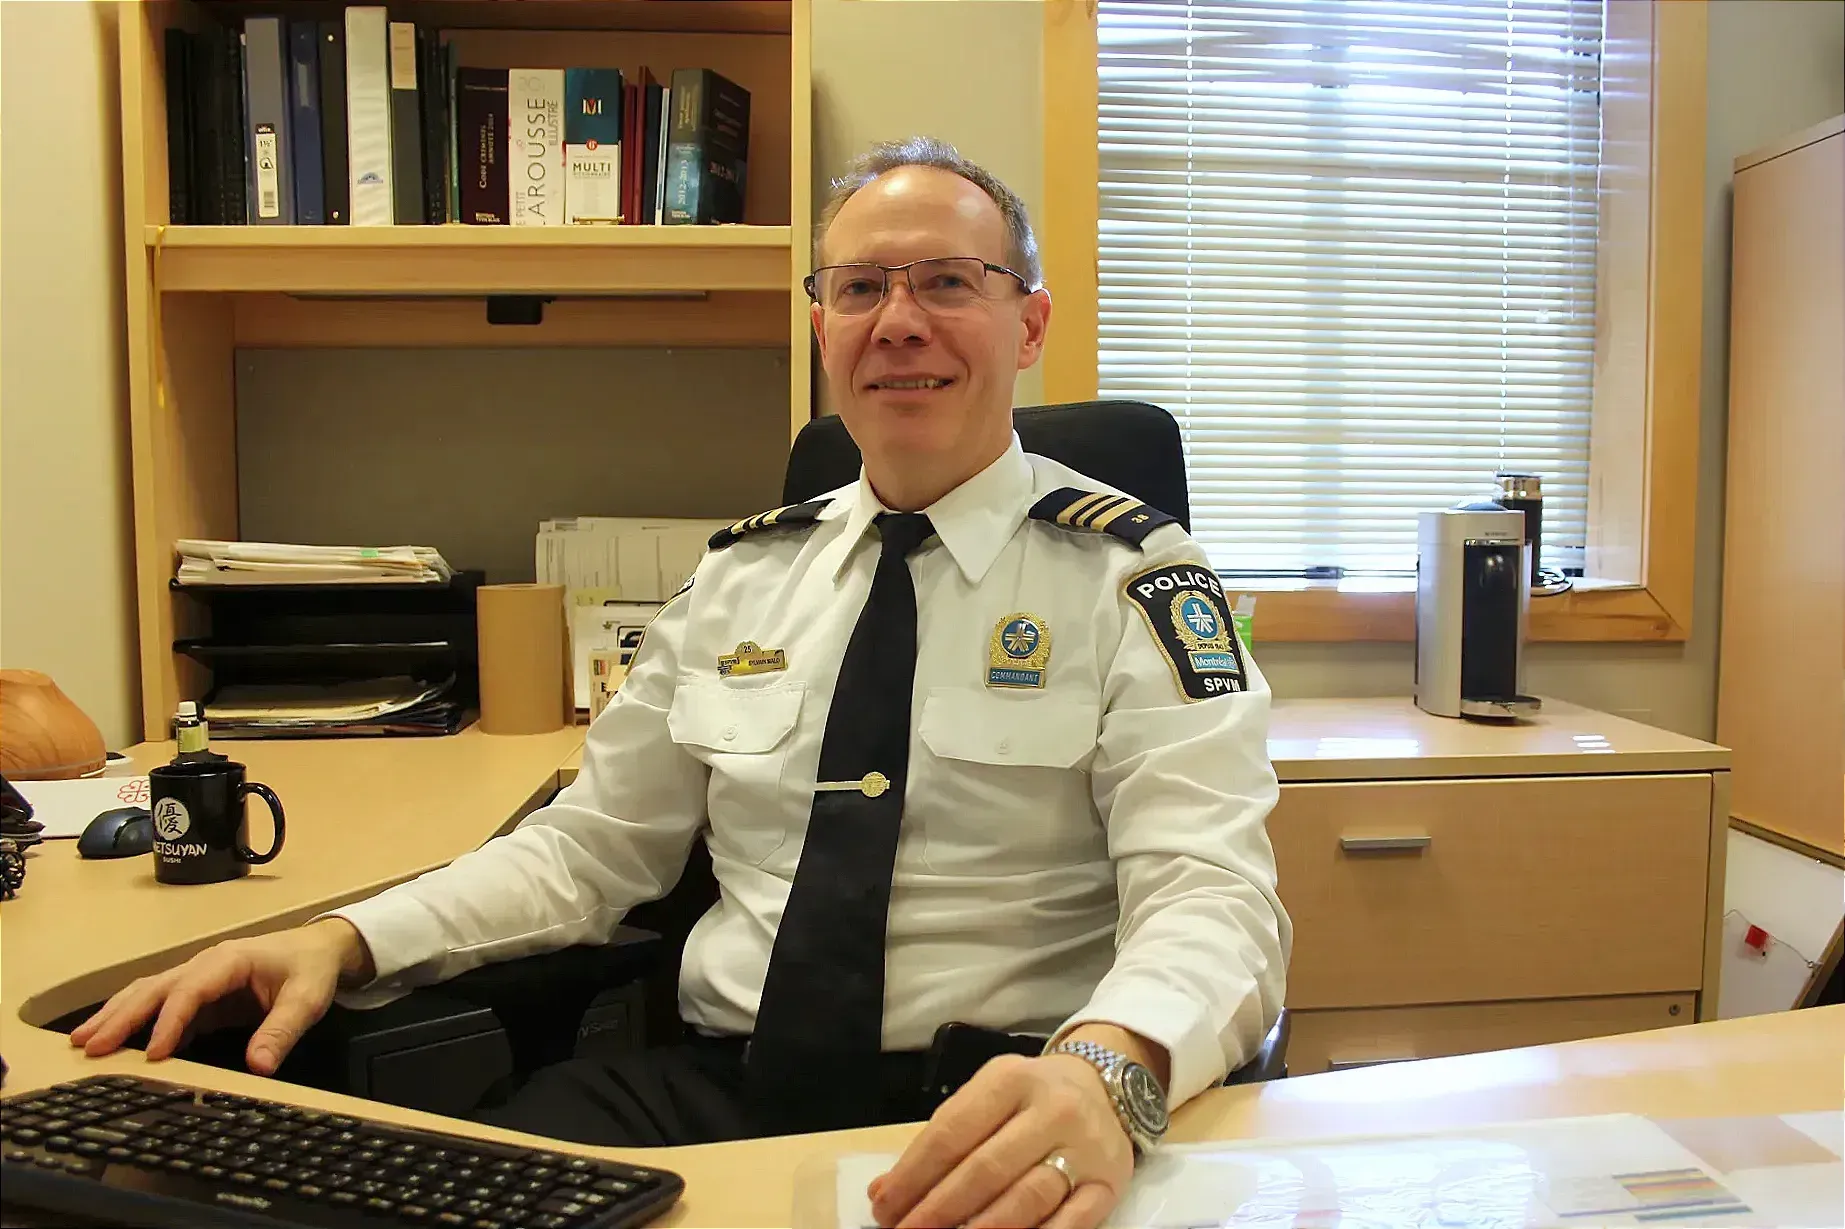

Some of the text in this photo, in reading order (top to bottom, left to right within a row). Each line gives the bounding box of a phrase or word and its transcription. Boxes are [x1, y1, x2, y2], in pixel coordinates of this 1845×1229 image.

[527, 98, 546, 226] AROUSSE
[573, 162, 611, 171] MULTI
[1136, 570, 1222, 599] POLICE
[744, 645, 752, 654] 25
[991, 671, 1039, 682] COMMANDANT
[1203, 677, 1240, 692] SPVM
